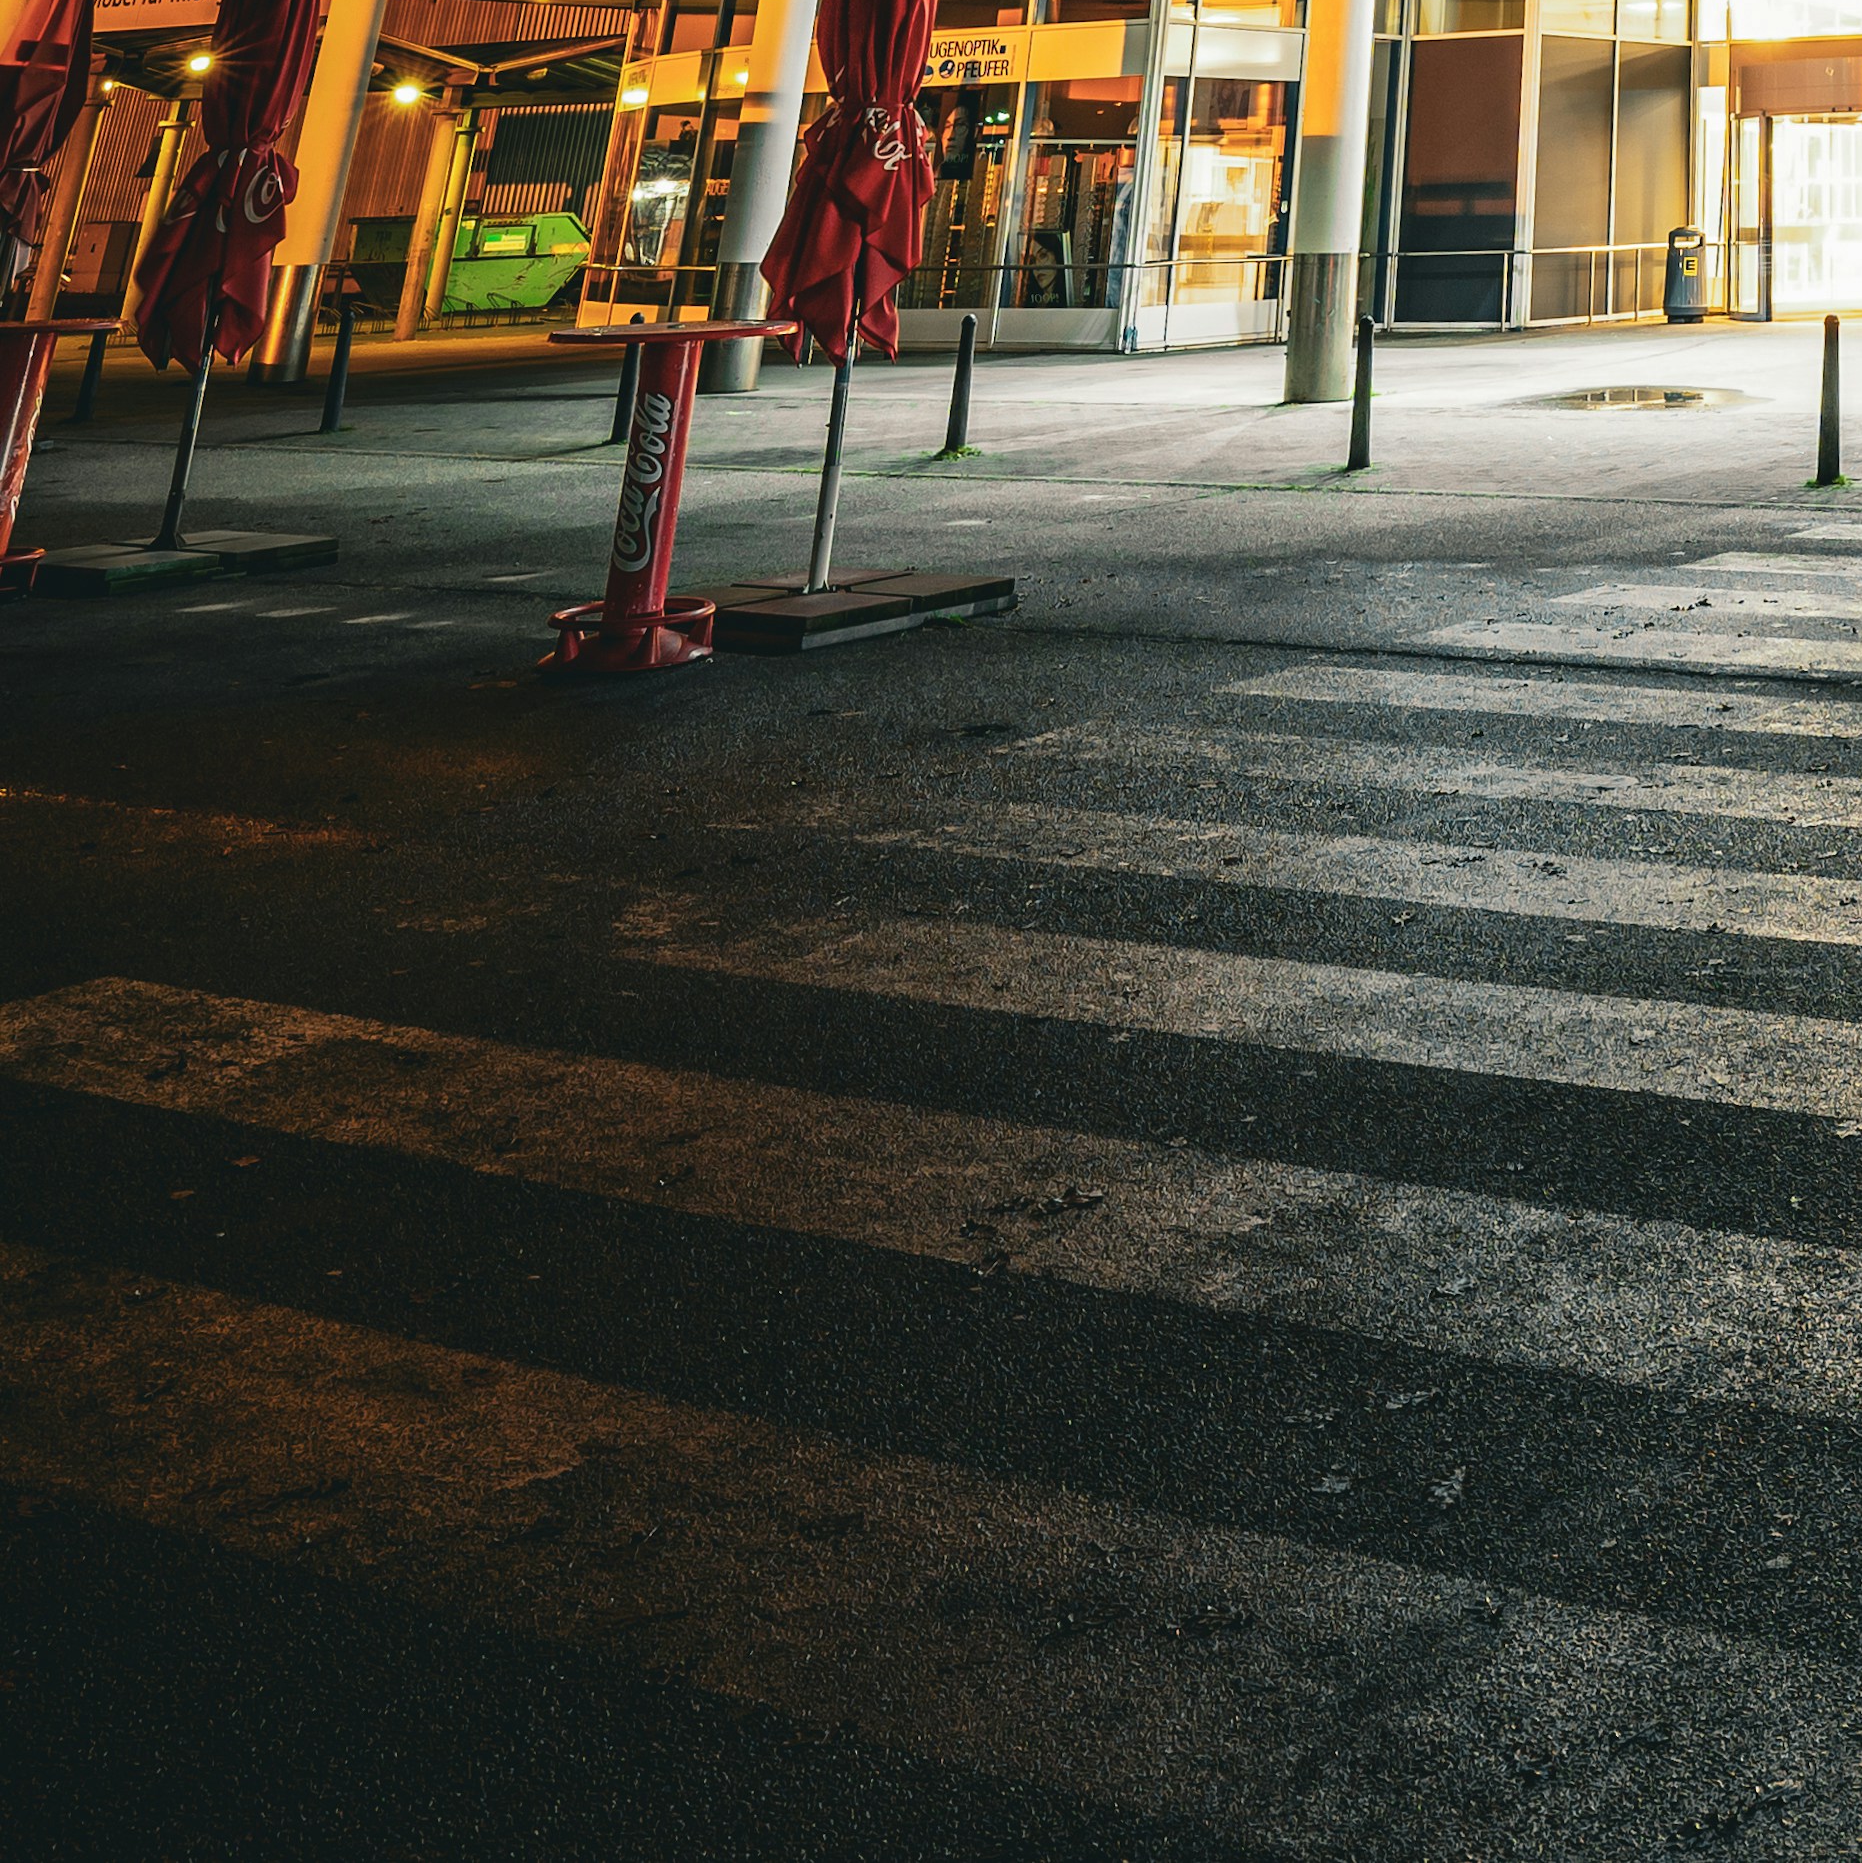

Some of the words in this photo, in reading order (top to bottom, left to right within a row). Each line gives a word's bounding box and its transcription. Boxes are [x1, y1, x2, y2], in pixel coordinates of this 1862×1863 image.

[929, 38, 1001, 58] UGENOPTIK
[956, 59, 1009, 79] PFEUFER
[613, 392, 672, 573] Coca-Cola
